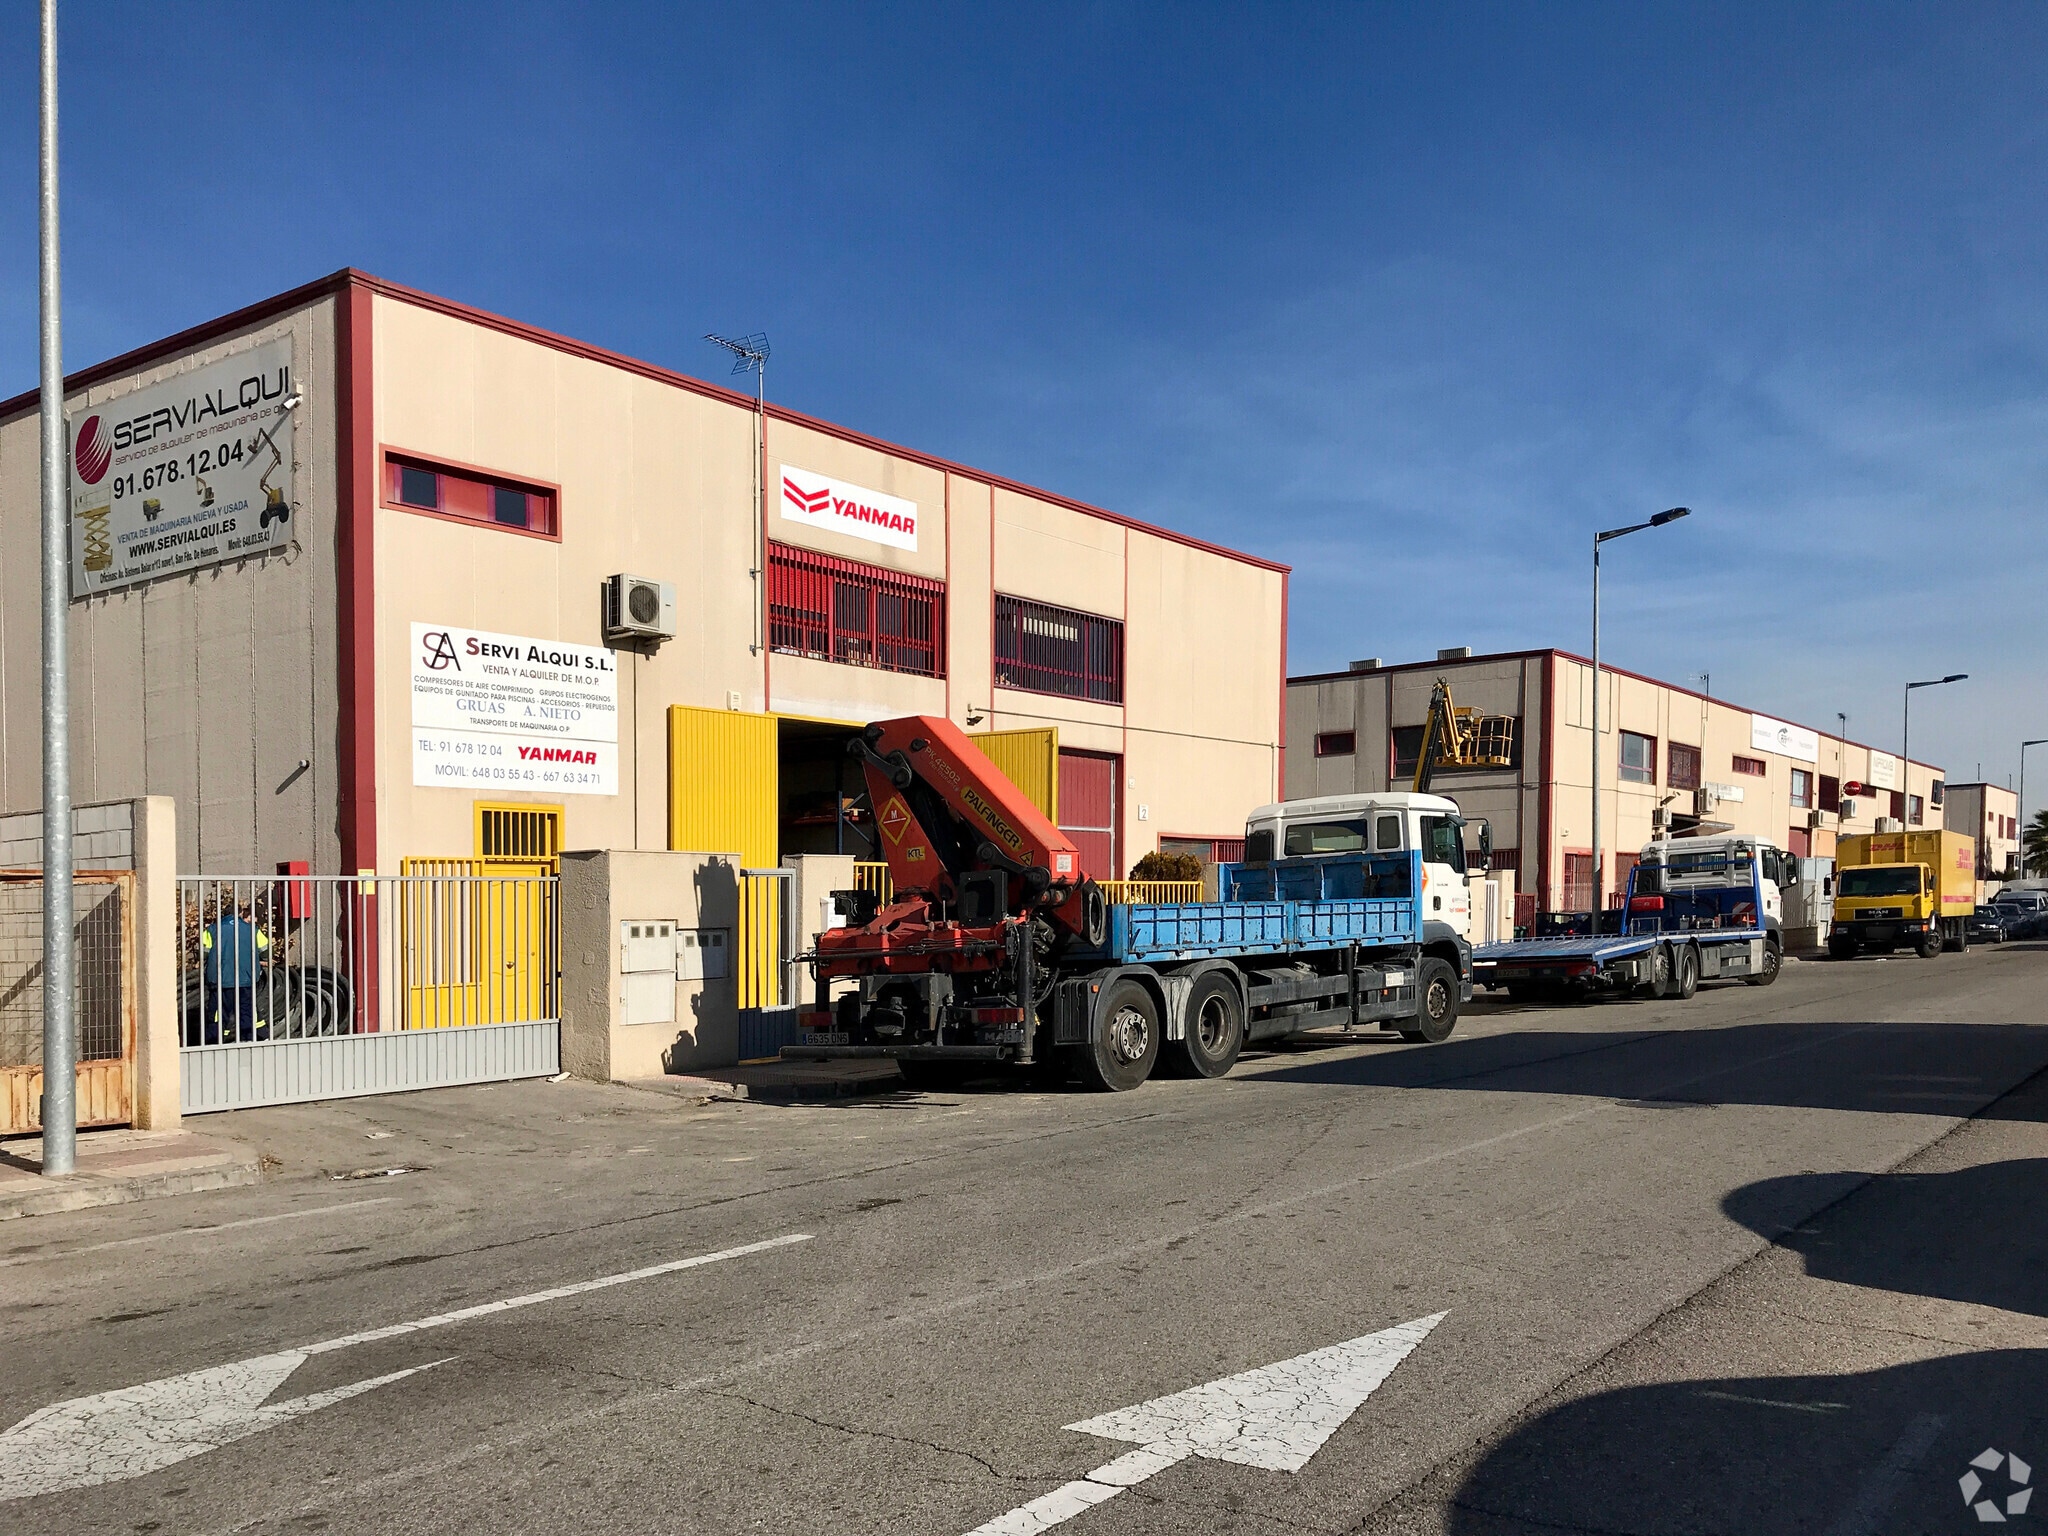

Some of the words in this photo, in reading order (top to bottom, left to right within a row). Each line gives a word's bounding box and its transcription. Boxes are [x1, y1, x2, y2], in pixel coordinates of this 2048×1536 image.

[114, 366, 289, 450] SERVIALQUI
[114, 439, 243, 499] 91.678.12.04
[118, 531, 139, 544] VENTA
[140, 528, 149, 539] DE
[150, 516, 192, 536] MAQUINARIA
[193, 509, 216, 524] NUEVA
[218, 506, 223, 515] Y
[224, 500, 248, 514] USADA
[832, 497, 915, 534] YANMAR
[129, 518, 237, 558] WWW.SERVIALQUI.ES
[466, 637, 519, 660] SERVI
[527, 646, 578, 667] ALQUI
[585, 656, 613, 672] S.L.
[483, 664, 510, 676] VENTA
[512, 668, 517, 676] Y
[520, 669, 559, 681] ALQUILER
[561, 673, 572, 682] DE
[414, 675, 464, 687] COMPRESORES
[475, 682, 489, 690] AIRE
[491, 684, 534, 695] COMPRIMIDO
[414, 685, 443, 695] EQUIPOS
[456, 690, 489, 699] GUNITADO
[491, 693, 506, 701] PARA
[508, 694, 535, 704] PISCINAS
[541, 699, 580, 708] ACCESORIOS
[586, 703, 615, 711] REPUESTOS
[540, 689, 564, 697] GRUPOS
[566, 692, 610, 702] ELECTROGENOS
[456, 699, 505, 714] GRUAS
[524, 705, 536, 716] A.
[540, 707, 581, 720] NIETO
[470, 717, 508, 727] TRANSPORTE
[520, 722, 558, 731] MAQUINARIA
[419, 740, 436, 751] TEL:
[440, 742, 451, 752] 91
[455, 743, 473, 754] 678
[477, 744, 486, 755] 12
[490, 745, 502, 756] 04
[518, 746, 597, 765] YANMAR
[435, 763, 469, 777] MÓVIL:
[472, 767, 490, 778] 648
[493, 768, 505, 779] 03
[508, 769, 520, 780] 55
[522, 769, 535, 780] 43
[543, 771, 559, 781] 667
[563, 772, 574, 782] 63
[577, 773, 588, 783] 34
[591, 774, 600, 784] 71
[924, 746, 936, 760] PK
[935, 758, 960, 785] 42502
[964, 790, 1020, 848] PALFINGER
[1142, 809, 1146, 818] 2
[908, 849, 923, 858] KTL
[808, 1034, 829, 1044] 6635
